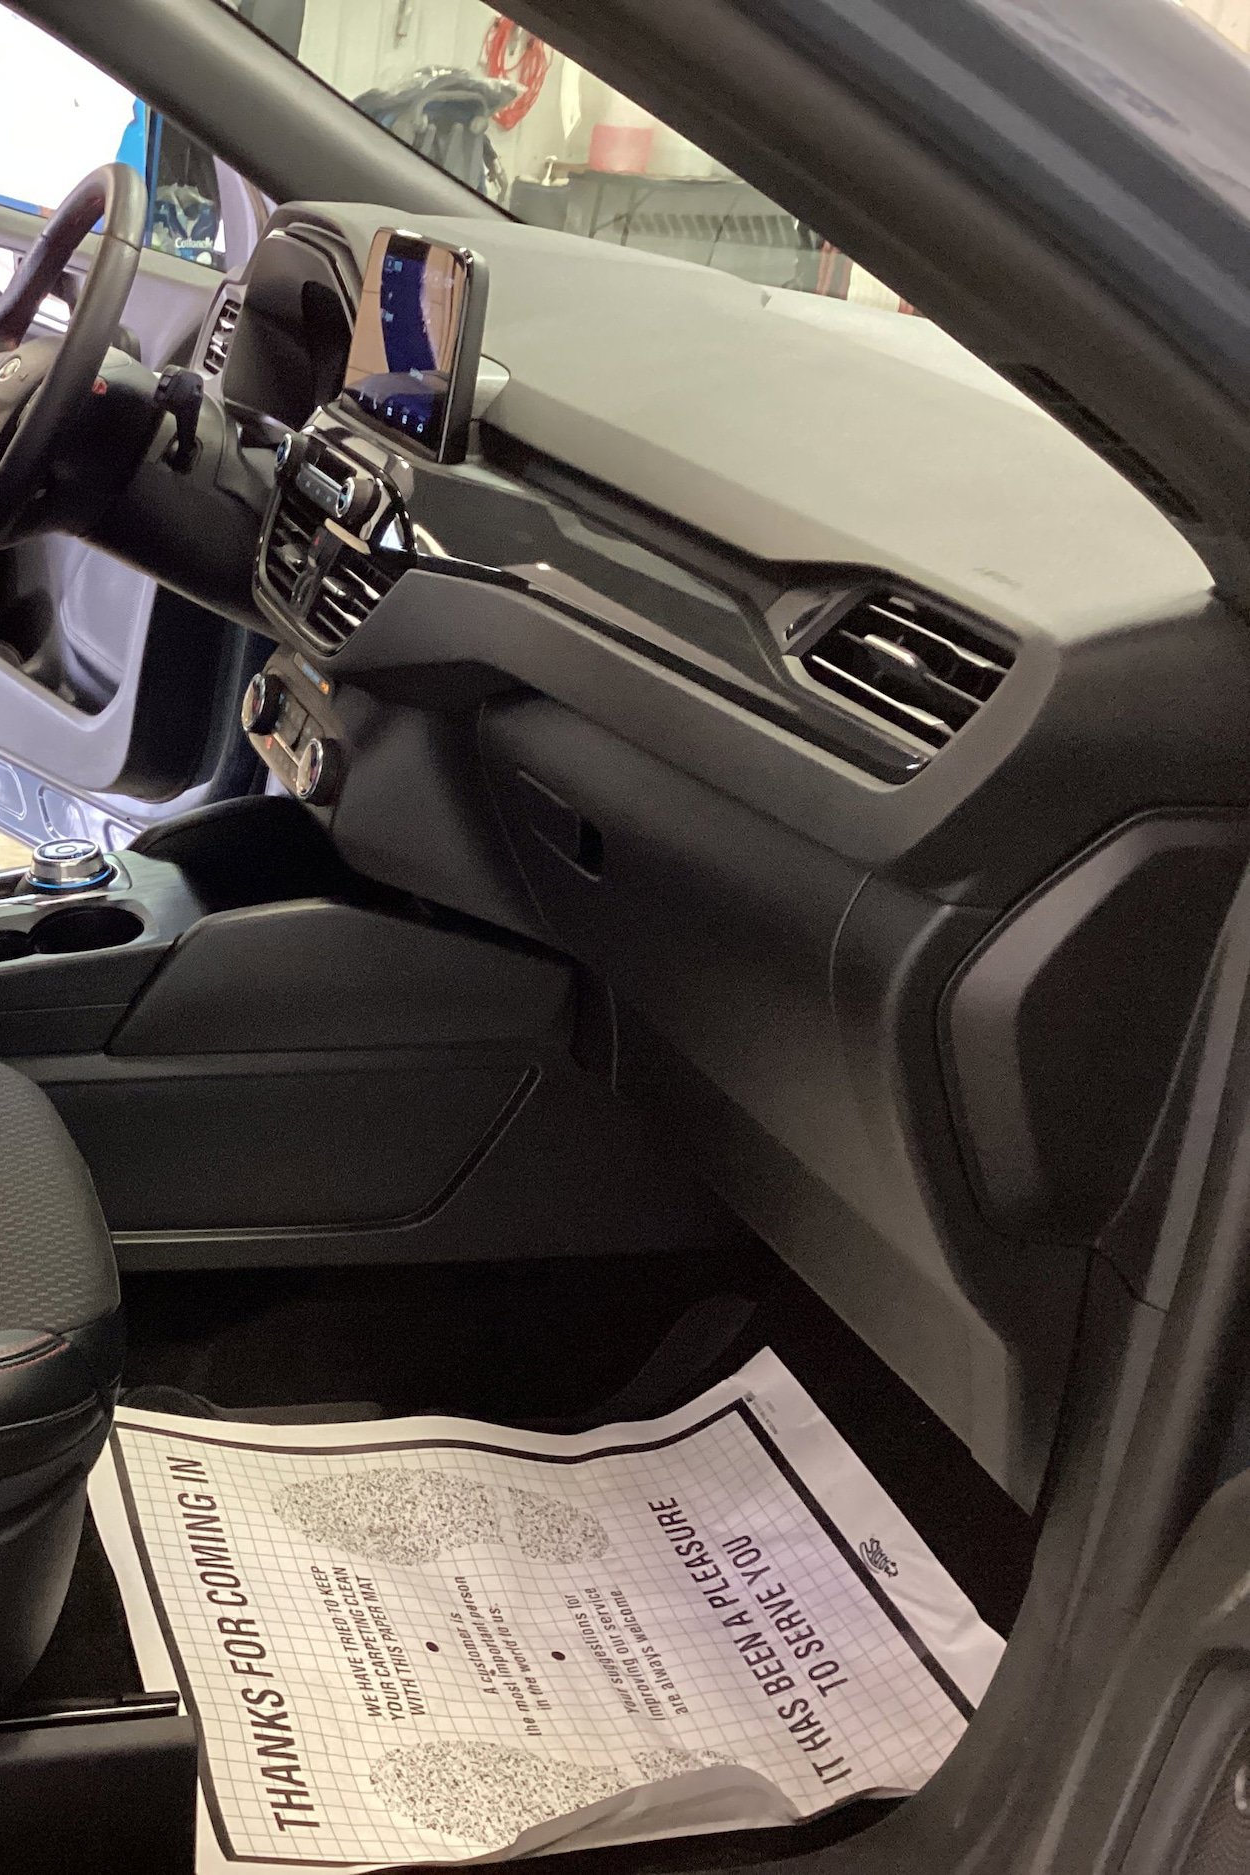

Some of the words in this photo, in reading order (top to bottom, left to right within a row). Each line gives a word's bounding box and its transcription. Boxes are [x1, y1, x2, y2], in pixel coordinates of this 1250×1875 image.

[166, 1456, 209, 1483] IN
[178, 1492, 248, 1607] COMING
[648, 1496, 740, 1610] PLEASURE
[721, 1535, 771, 1586] YOU
[311, 1565, 334, 1596] KEEP
[332, 1566, 358, 1606] CLEAN
[356, 1575, 379, 1602] MAT
[454, 1576, 484, 1619] person
[324, 1599, 342, 1614] TO
[450, 1612, 463, 1624] is
[564, 1594, 582, 1609] for
[584, 1587, 616, 1631] service
[722, 1610, 754, 1628] A
[332, 1617, 358, 1652] TRIED
[368, 1606, 398, 1642] PAPER
[497, 1626, 512, 1637] to
[755, 1581, 825, 1660] SERVE
[217, 1615, 274, 1678] FOR
[349, 1609, 390, 1677] CARPETING
[387, 1646, 411, 1674] THIS
[457, 1627, 492, 1683] customer
[472, 1622, 512, 1678] important
[502, 1640, 531, 1672] world
[575, 1612, 623, 1685] suggestions
[608, 1634, 629, 1655] our
[348, 1657, 373, 1690] HAVE
[642, 1645, 674, 1690] always
[733, 1630, 796, 1697] BEEN
[808, 1659, 848, 1698] TO
[380, 1682, 405, 1721] YOUR
[400, 1679, 426, 1715] WITH
[483, 1687, 500, 1695] A
[502, 1681, 530, 1712] most
[525, 1676, 544, 1695] the
[617, 1687, 640, 1714] Your
[622, 1658, 665, 1721] improving
[362, 1694, 382, 1717] WE
[537, 1699, 552, 1711] in
[667, 1693, 689, 1715] are
[523, 1717, 542, 1736] the
[777, 1698, 832, 1753] HAS
[242, 1687, 320, 1831] THANKS
[811, 1755, 852, 1785] IT
